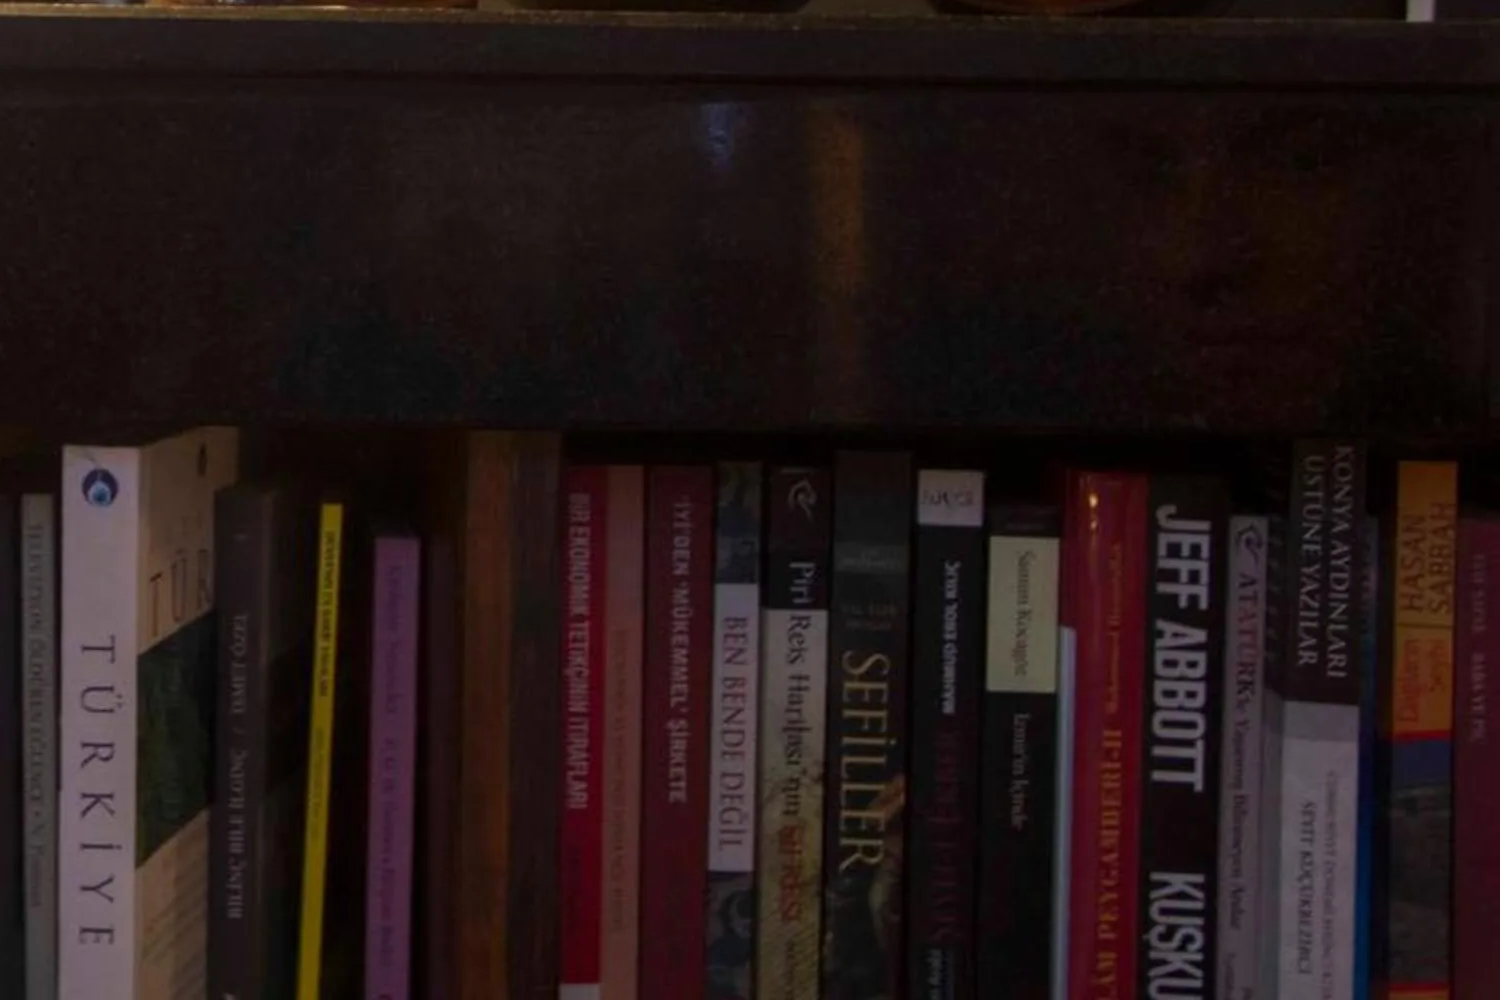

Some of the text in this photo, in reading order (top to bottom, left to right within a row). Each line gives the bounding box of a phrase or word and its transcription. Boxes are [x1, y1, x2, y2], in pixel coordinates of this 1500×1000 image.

[786, 614, 813, 665] Reis
[788, 560, 819, 605] Piri
[1149, 503, 1212, 793] JEFF ABBOTT
[1296, 454, 1326, 667] ÜSTÜNE YAZILAR
[1325, 444, 1353, 680] KONYA AYDINLARI
[1399, 501, 1457, 615] HASAN SABBAH
[79, 634, 123, 946] TÜRKİYE
[665, 718, 692, 805] ŞİRKETE
[717, 615, 750, 852] BEN BENDE DEĞİL
[837, 649, 897, 874] SEFİLLER
